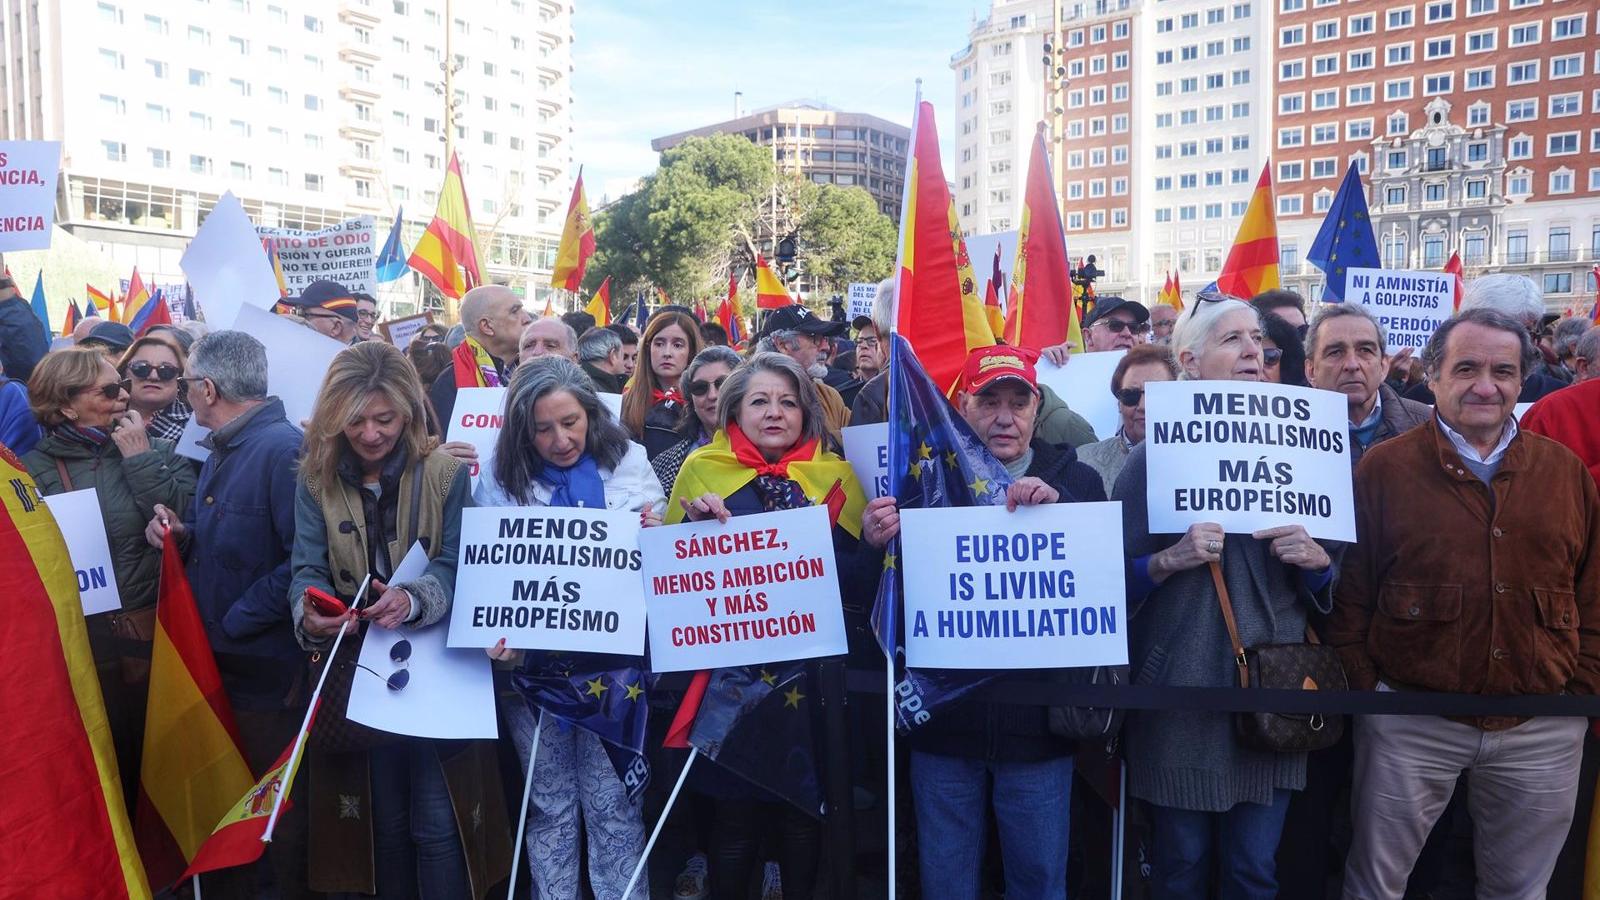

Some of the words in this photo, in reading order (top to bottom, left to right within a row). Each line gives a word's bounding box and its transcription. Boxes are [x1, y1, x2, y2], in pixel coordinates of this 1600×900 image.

[0, 216, 44, 232] NCIA
[308, 237, 329, 248] DE
[334, 232, 370, 246] ODIO
[314, 251, 321, 259] Y
[325, 246, 372, 259] GUERRA
[282, 262, 299, 272] NO
[302, 262, 319, 271] TE
[322, 258, 372, 271] QUIERE!!!
[288, 275, 304, 284] TE
[1353, 275, 1370, 288] NI
[1375, 276, 1449, 293] AMNISTÍA
[1362, 292, 1371, 305] A
[1375, 292, 1439, 309] GOLPISTAS
[1193, 393, 1311, 421] MENOS
[1154, 420, 1344, 454] NACIONALISMOS
[1219, 456, 1293, 485] MÁS
[1175, 485, 1332, 518] EUROPEÍSMO
[498, 518, 608, 542] MENOS
[674, 528, 788, 560] SÁNCHEZ,
[464, 543, 642, 571] NACIONALISMOS
[956, 532, 1066, 563] EUROPE
[653, 570, 716, 595] MENOS
[722, 554, 825, 589] AMBICIÓN
[949, 572, 975, 601] IS
[984, 569, 1075, 600] LIVING
[512, 575, 581, 604] MÁS
[706, 597, 718, 617] Y
[724, 588, 769, 616] MÁS
[472, 603, 620, 634] EUROPEÍSMO
[671, 610, 816, 648] CONSTITUCIÓN
[913, 610, 929, 638] A
[937, 606, 1117, 639] HUMILIATION
[895, 680, 931, 725] ppe
